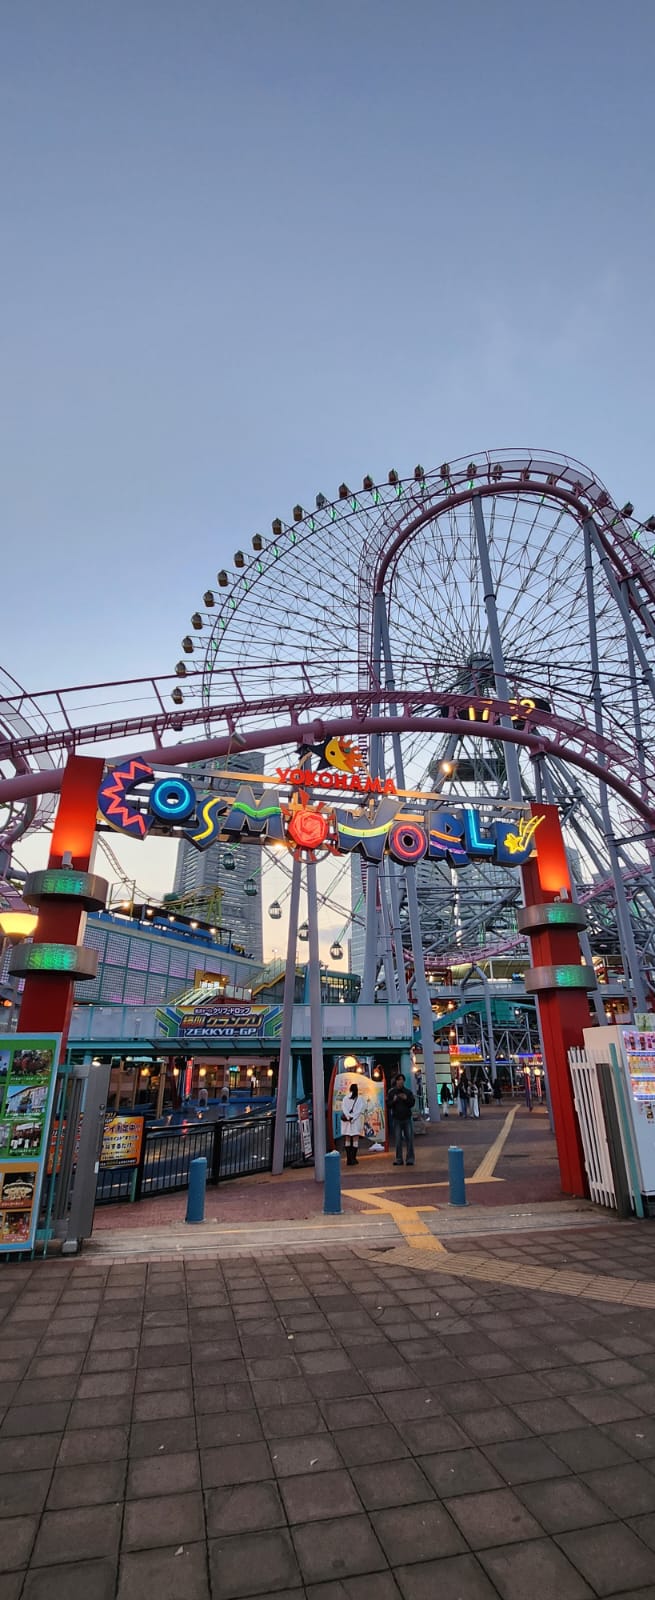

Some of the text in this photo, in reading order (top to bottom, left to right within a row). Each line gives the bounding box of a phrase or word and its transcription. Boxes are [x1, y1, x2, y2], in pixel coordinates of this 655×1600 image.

[275, 767, 397, 795] YOKOHAMA
[97, 756, 541, 868] COSMO WORLD
[186, 1028, 256, 1036] ZEKKYO-GP
